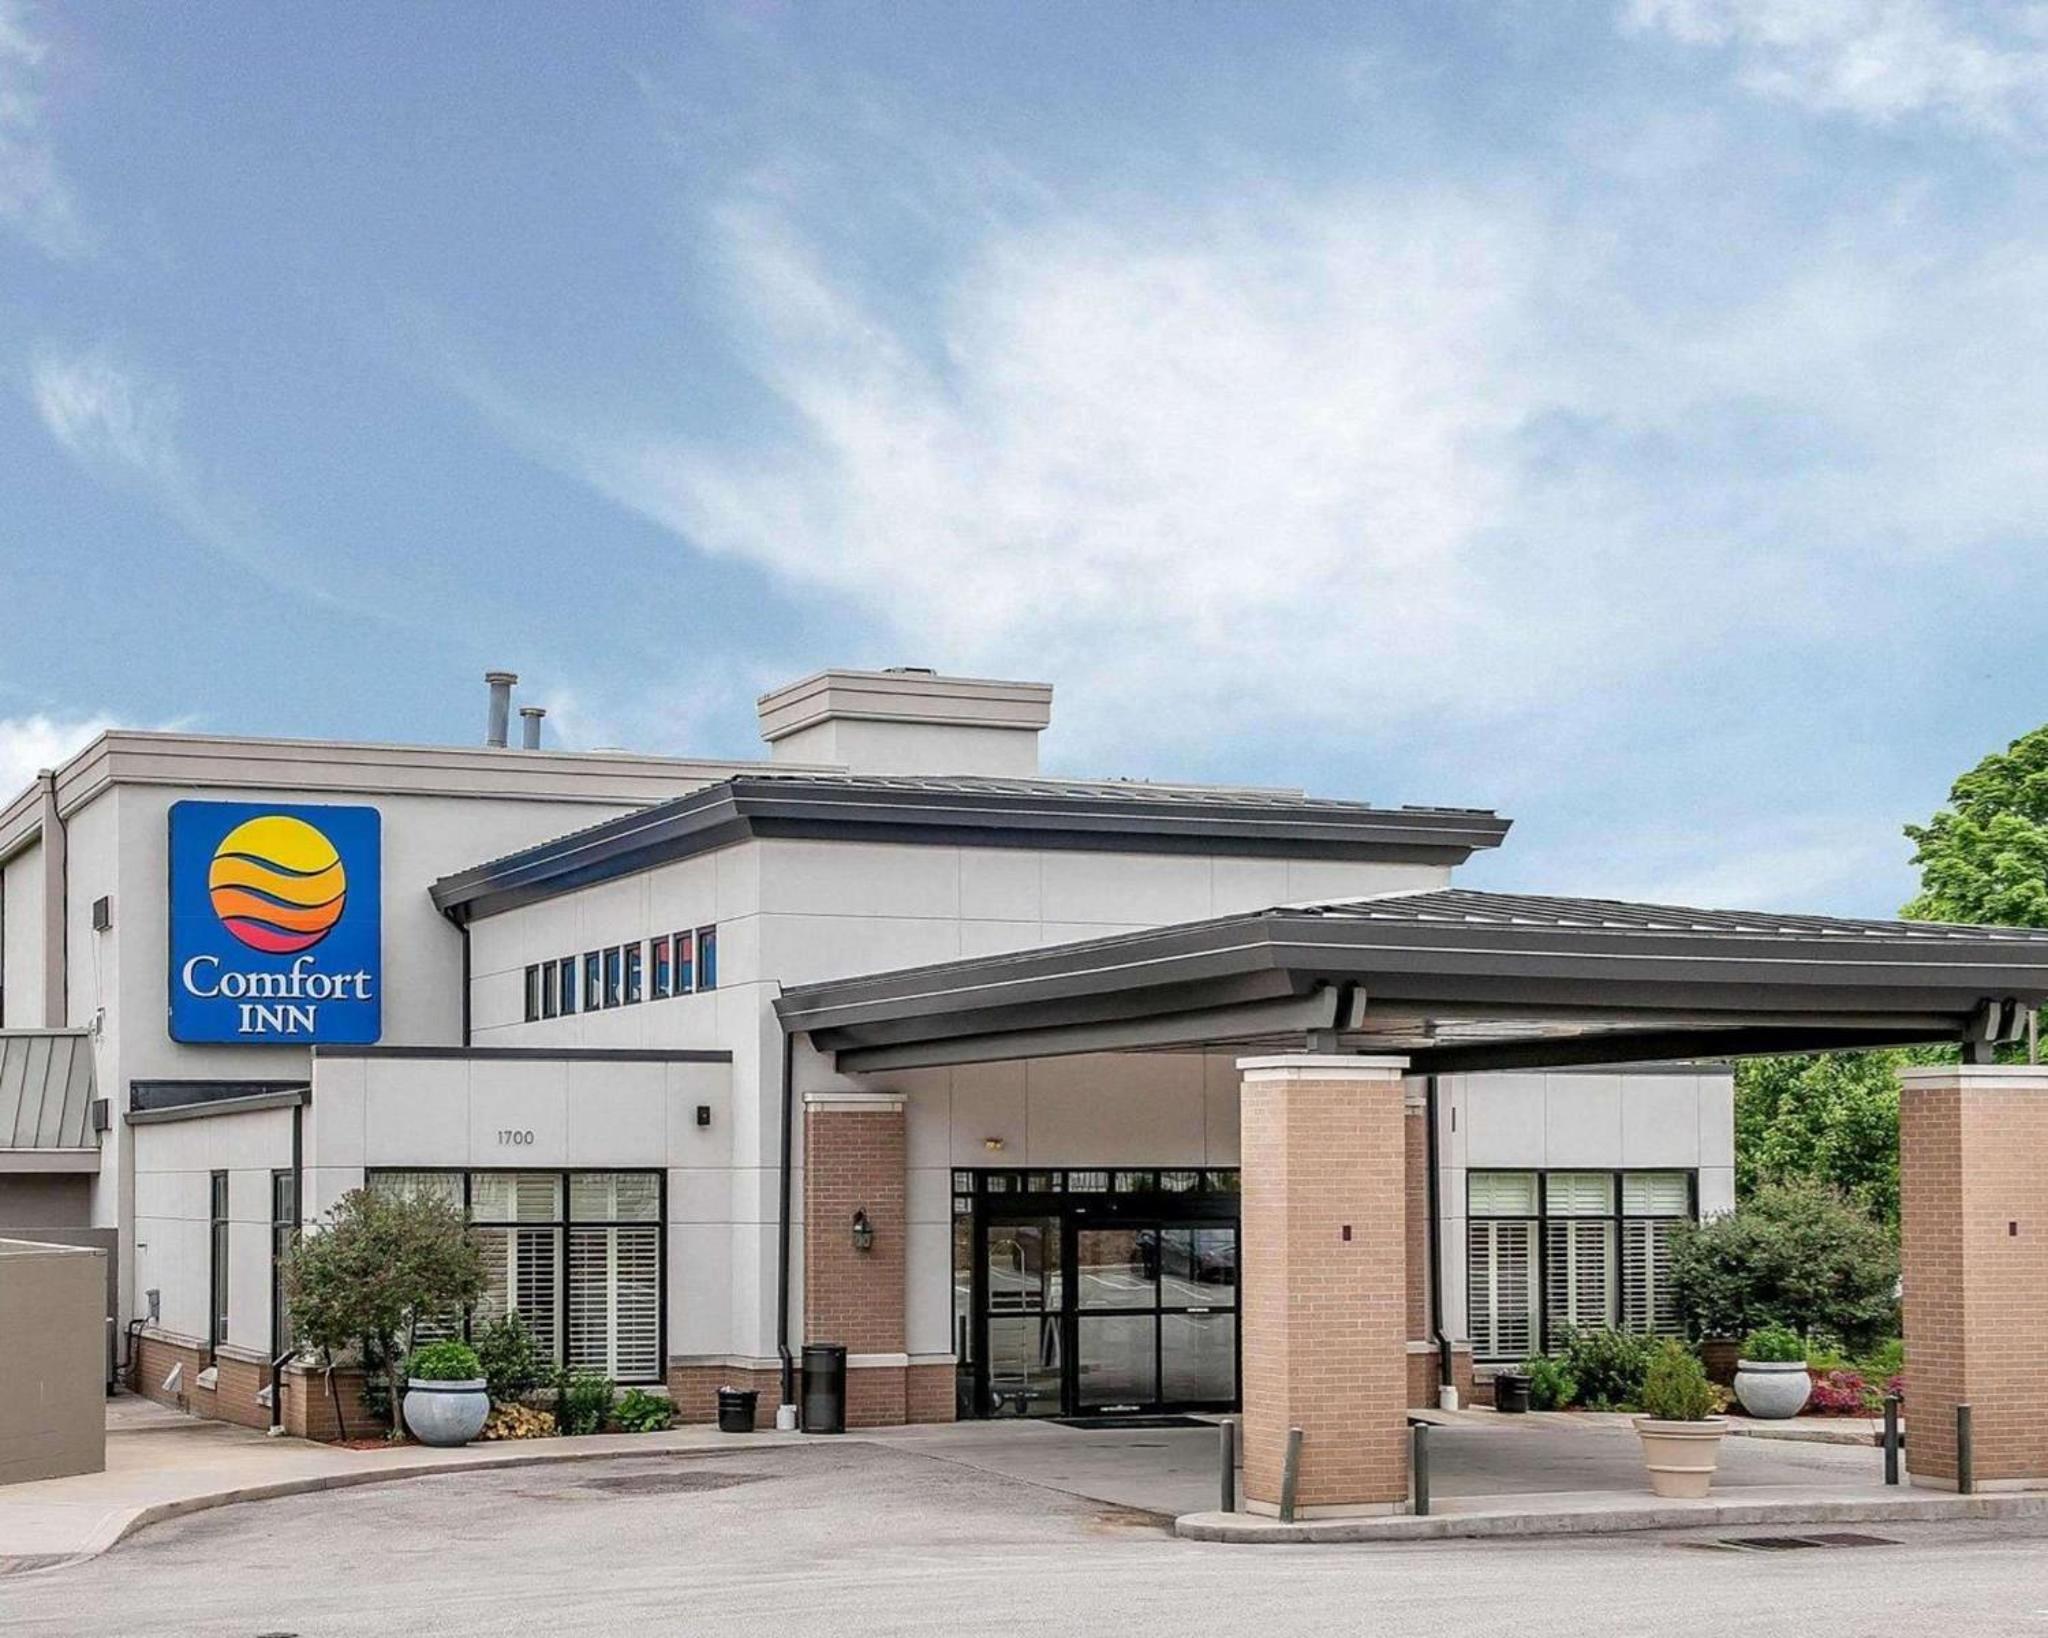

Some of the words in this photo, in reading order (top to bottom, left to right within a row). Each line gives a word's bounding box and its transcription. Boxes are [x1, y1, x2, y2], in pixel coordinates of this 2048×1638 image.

[182, 954, 373, 999] Comfort
[237, 1003, 317, 1034] INN
[498, 1130, 535, 1145] 1700
